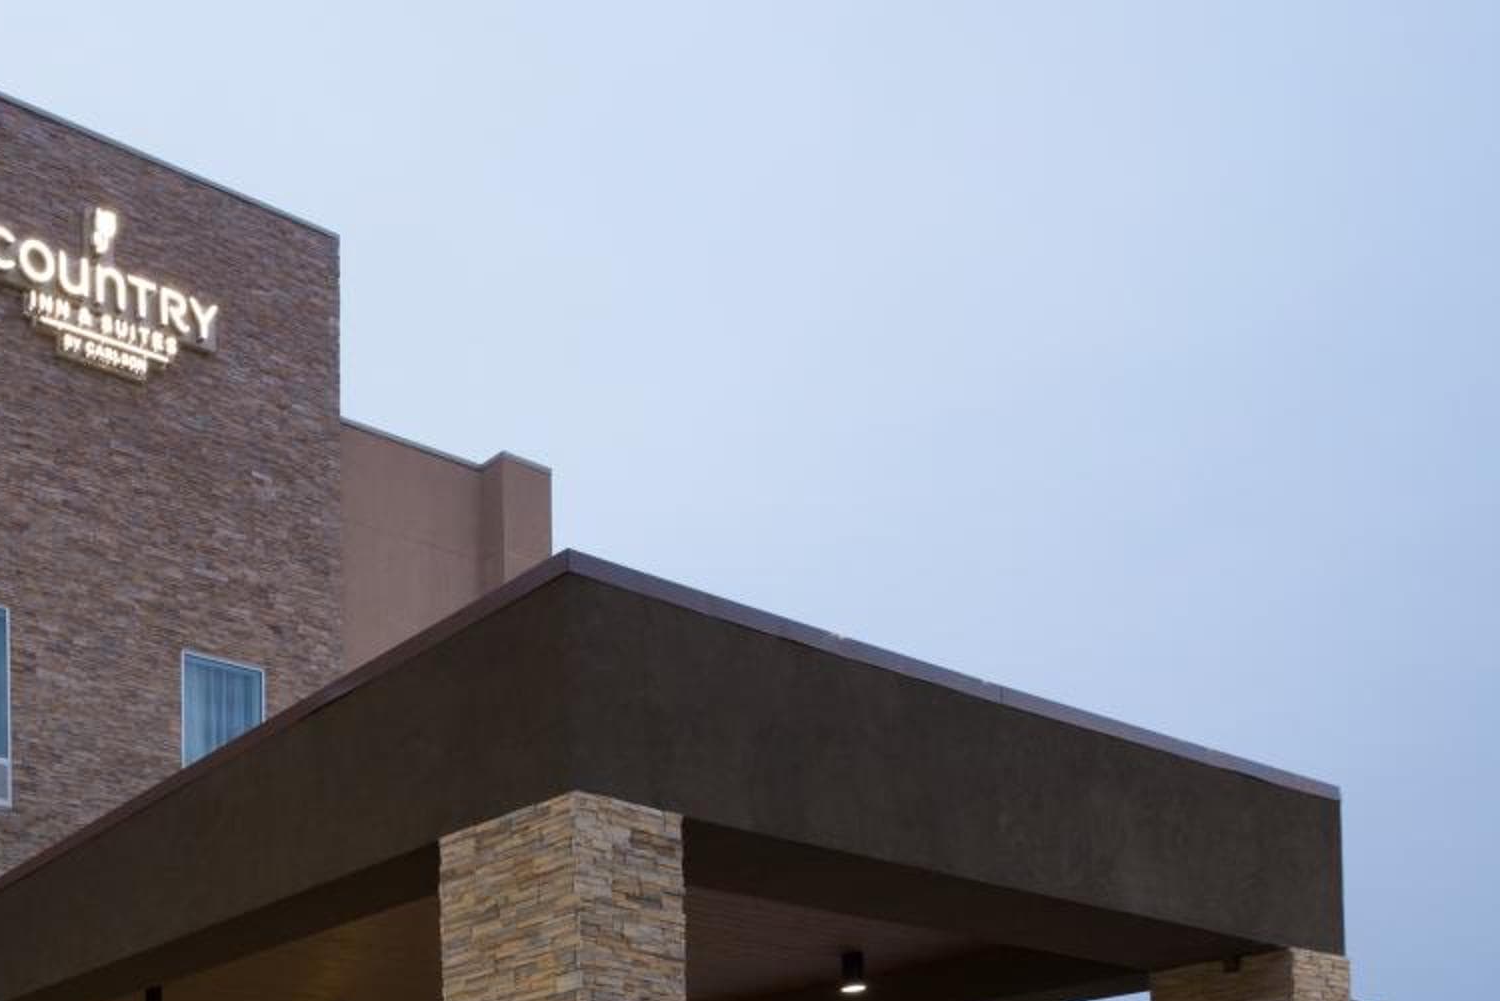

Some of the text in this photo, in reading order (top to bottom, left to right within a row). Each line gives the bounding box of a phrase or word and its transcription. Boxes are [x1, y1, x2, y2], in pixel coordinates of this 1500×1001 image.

[29, 289, 178, 355] INN & SUITES
[63, 333, 82, 352] BY
